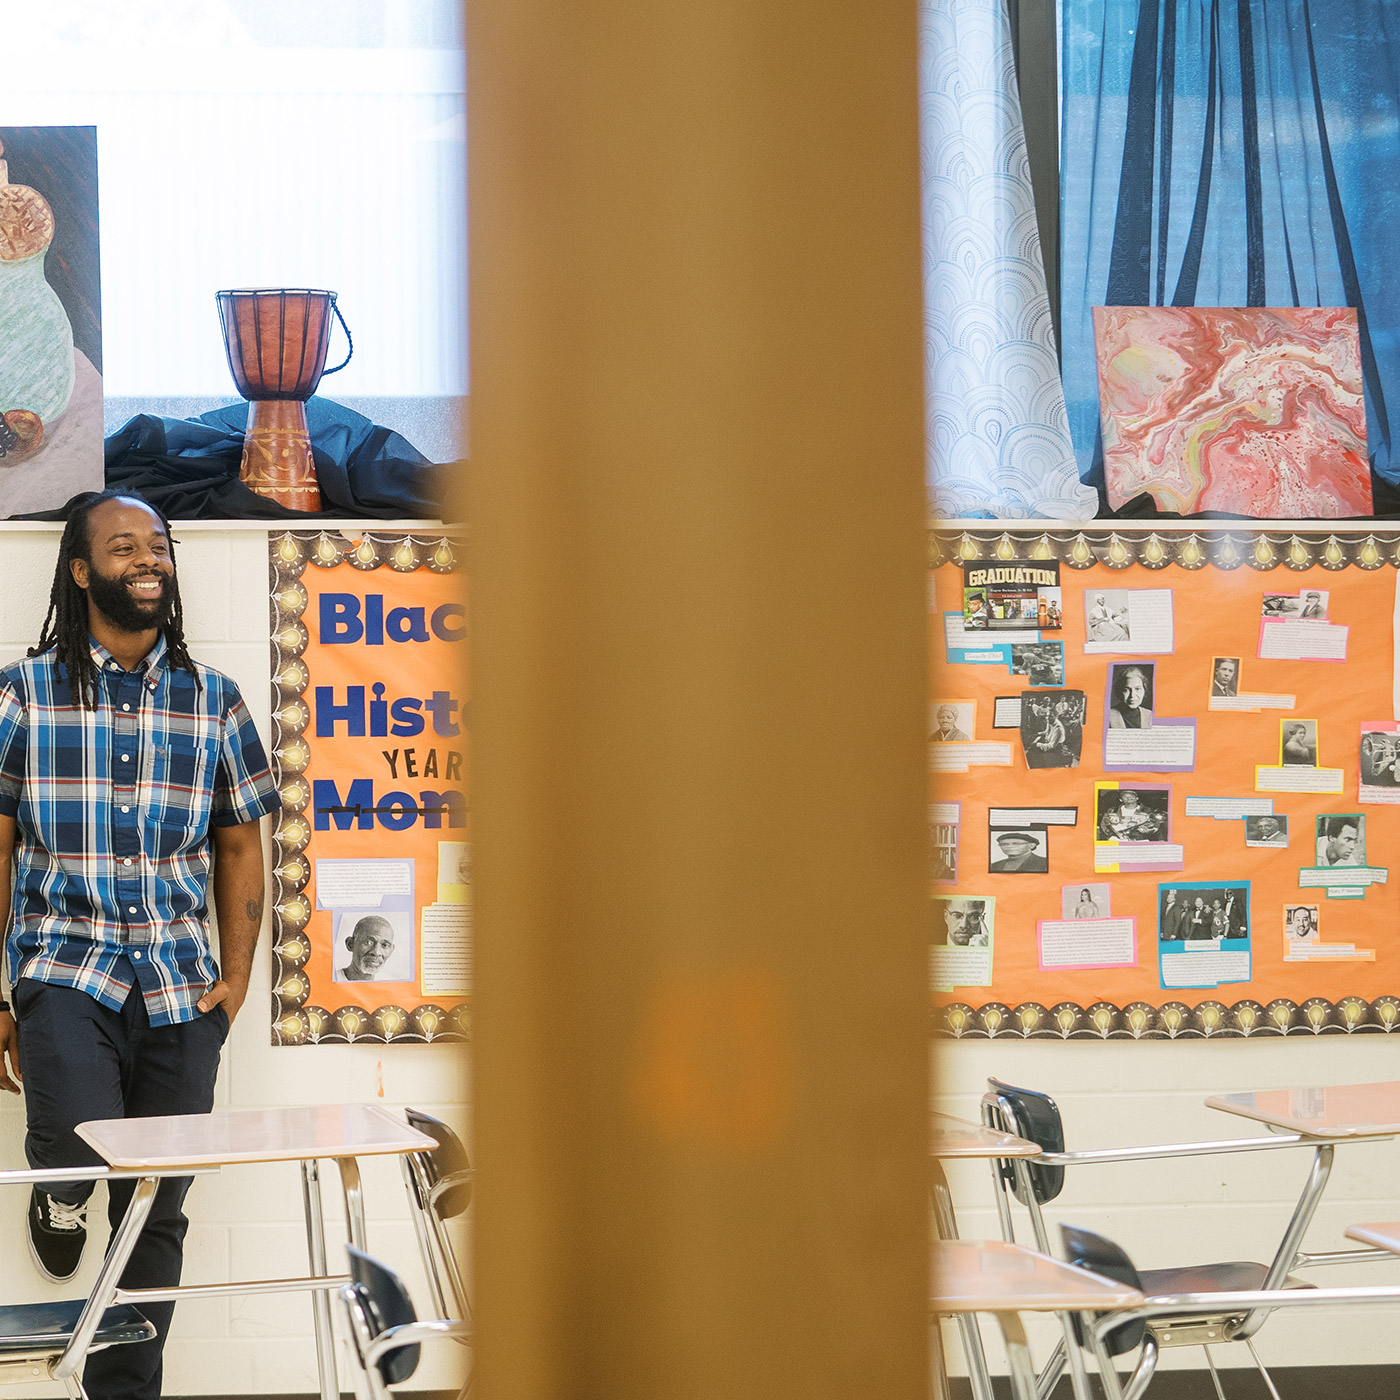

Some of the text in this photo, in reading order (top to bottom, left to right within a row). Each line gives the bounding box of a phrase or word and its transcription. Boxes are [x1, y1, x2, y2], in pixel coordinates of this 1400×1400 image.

[969, 567, 1056, 586] GRADUATION
[319, 593, 467, 645] Blac
[382, 748, 463, 781] YEAR
[313, 779, 467, 831] Mon
